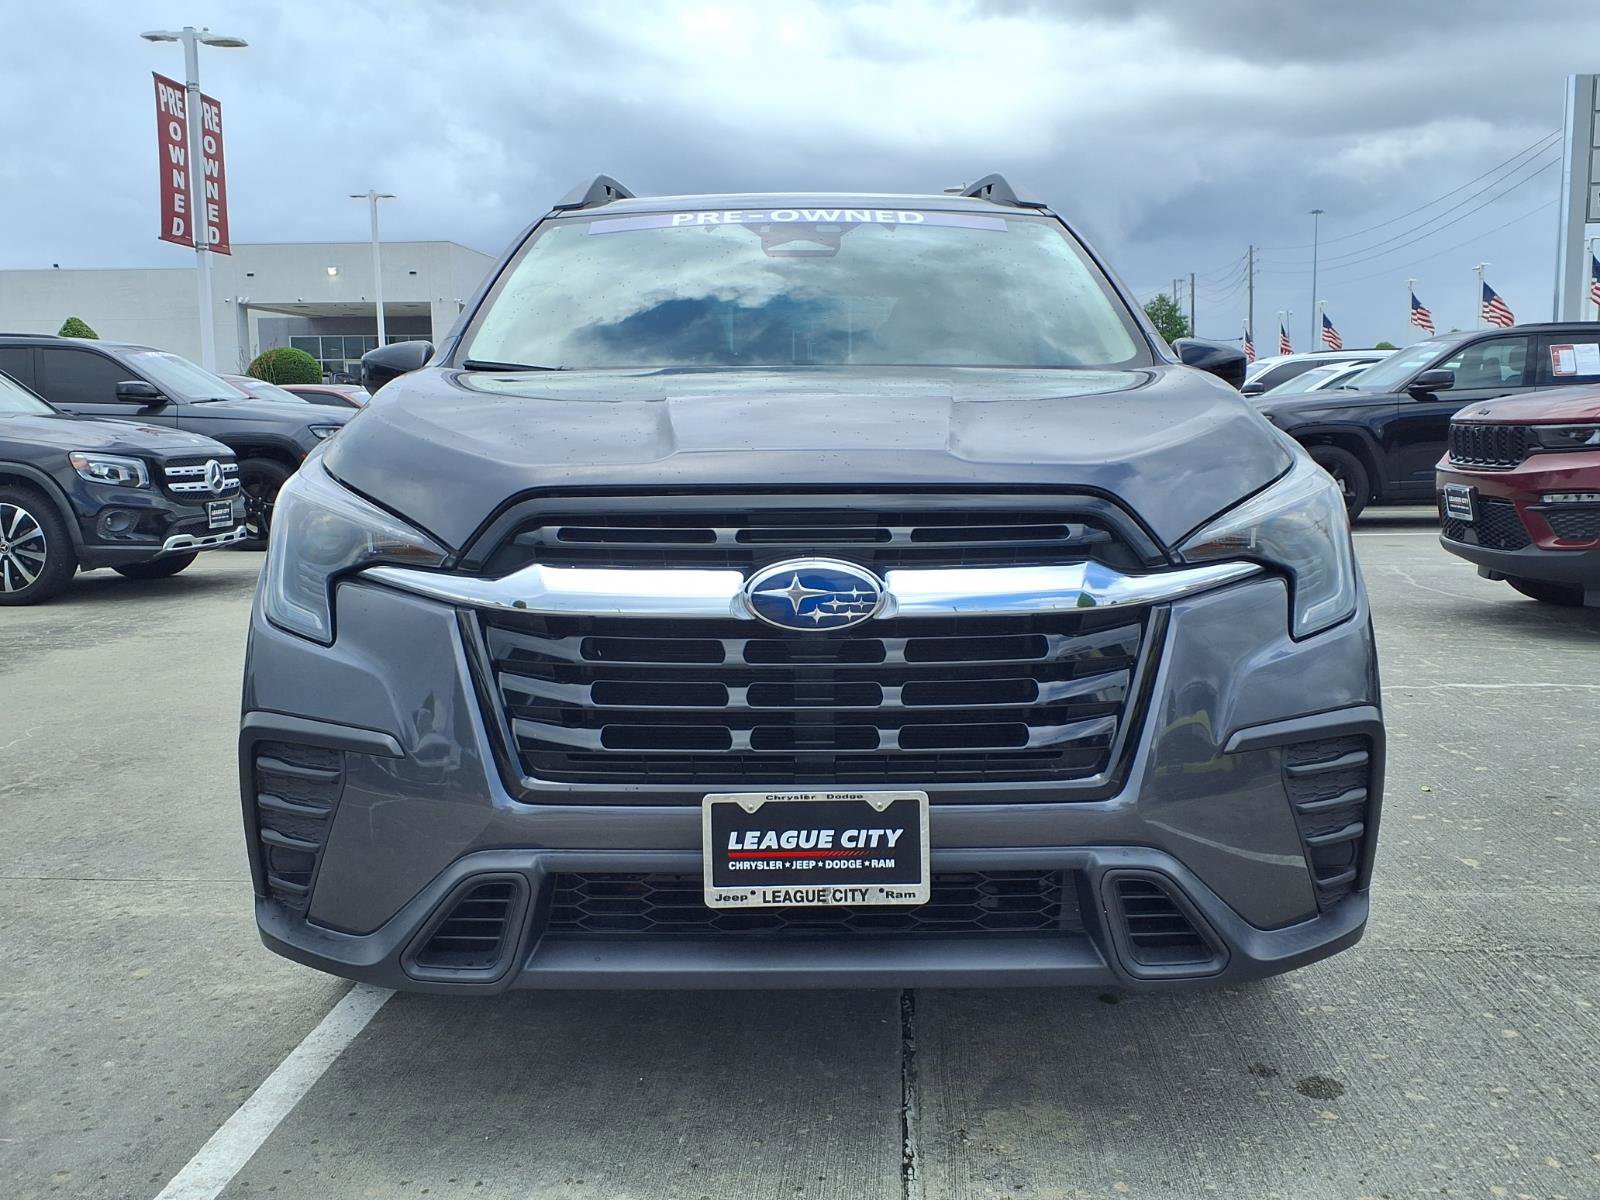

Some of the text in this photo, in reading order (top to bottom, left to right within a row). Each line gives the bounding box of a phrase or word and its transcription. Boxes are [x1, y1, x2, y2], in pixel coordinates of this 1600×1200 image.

[157, 83, 185, 120] PRE
[200, 101, 221, 134] RE
[168, 121, 185, 236] OWNED
[202, 135, 220, 245] OWNED
[671, 209, 925, 226] PRE-OWNED
[727, 828, 904, 850] LEAGUE CITY
[728, 859, 895, 870] CHRYSLER JEEP DODGE RAM
[714, 888, 917, 904] Jeep LEAGUE CITY Ram
